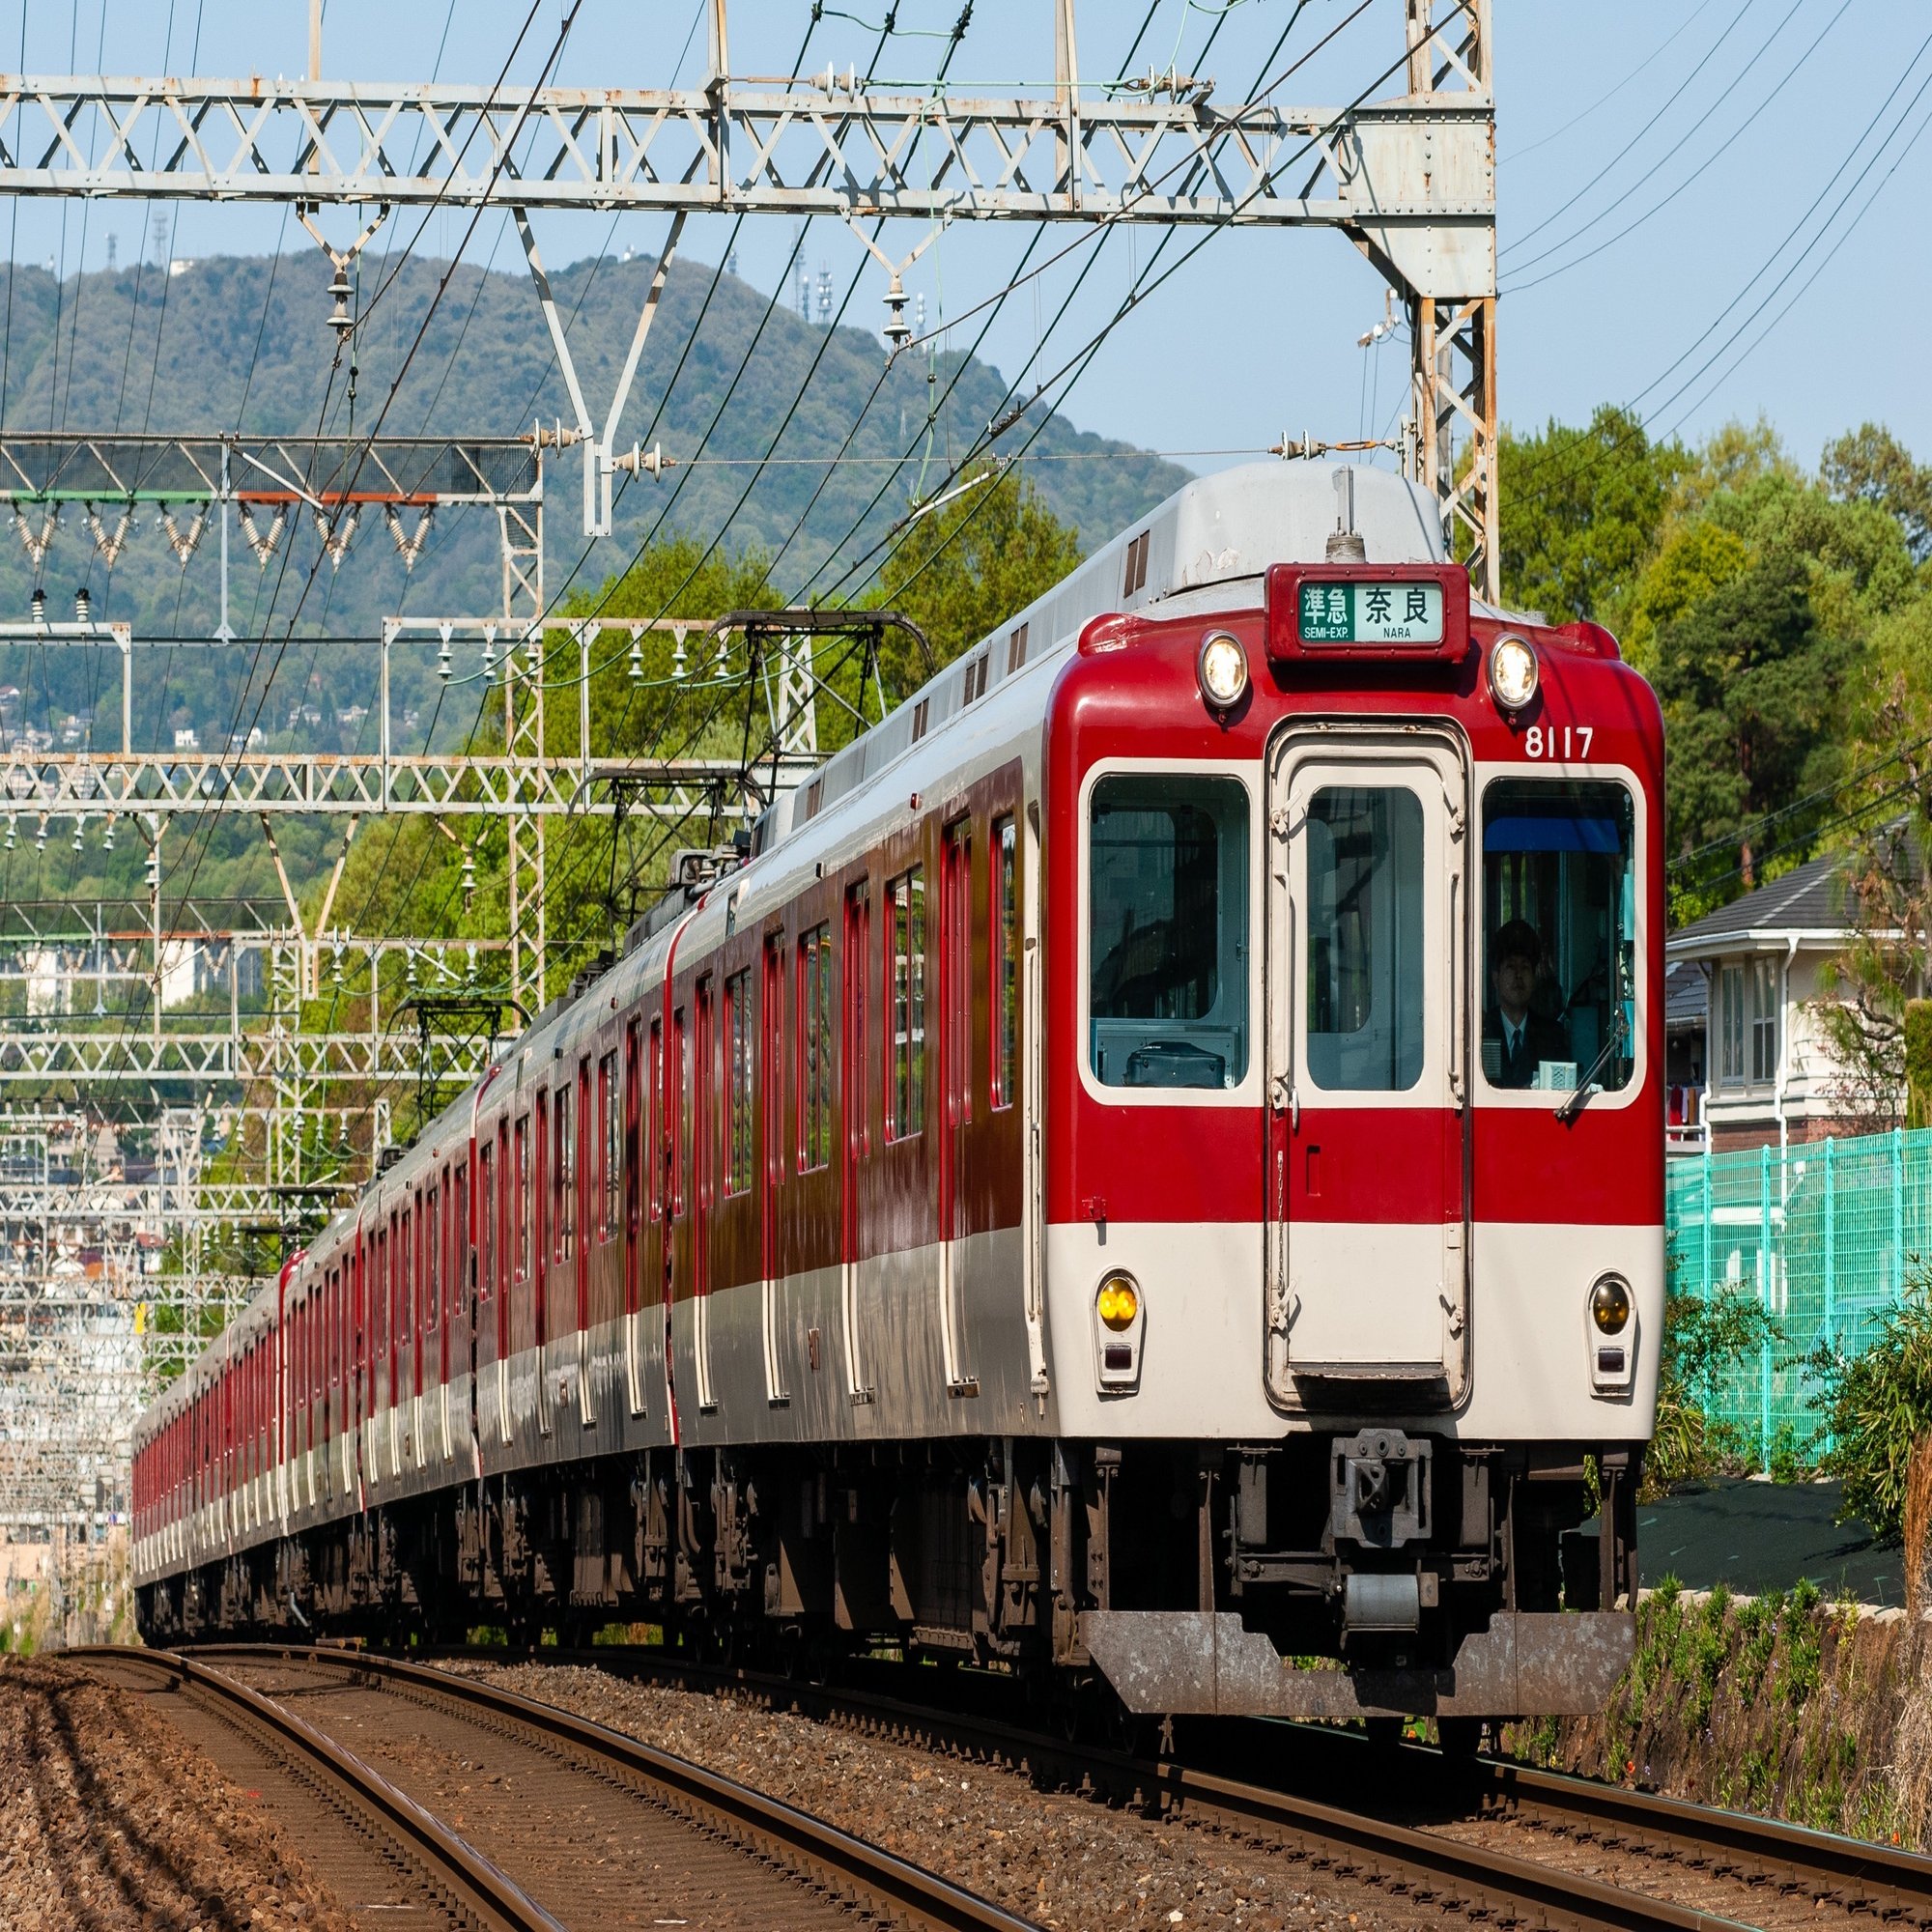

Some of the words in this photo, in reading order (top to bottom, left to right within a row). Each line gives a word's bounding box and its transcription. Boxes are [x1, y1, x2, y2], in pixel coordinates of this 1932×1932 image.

[1304, 587, 1348, 625] 準急
[1366, 587, 1429, 624] 奈良
[1304, 627, 1349, 639] SEMI-EXP.
[1383, 628, 1411, 639] NARA
[1525, 725, 1593, 758] 8117
